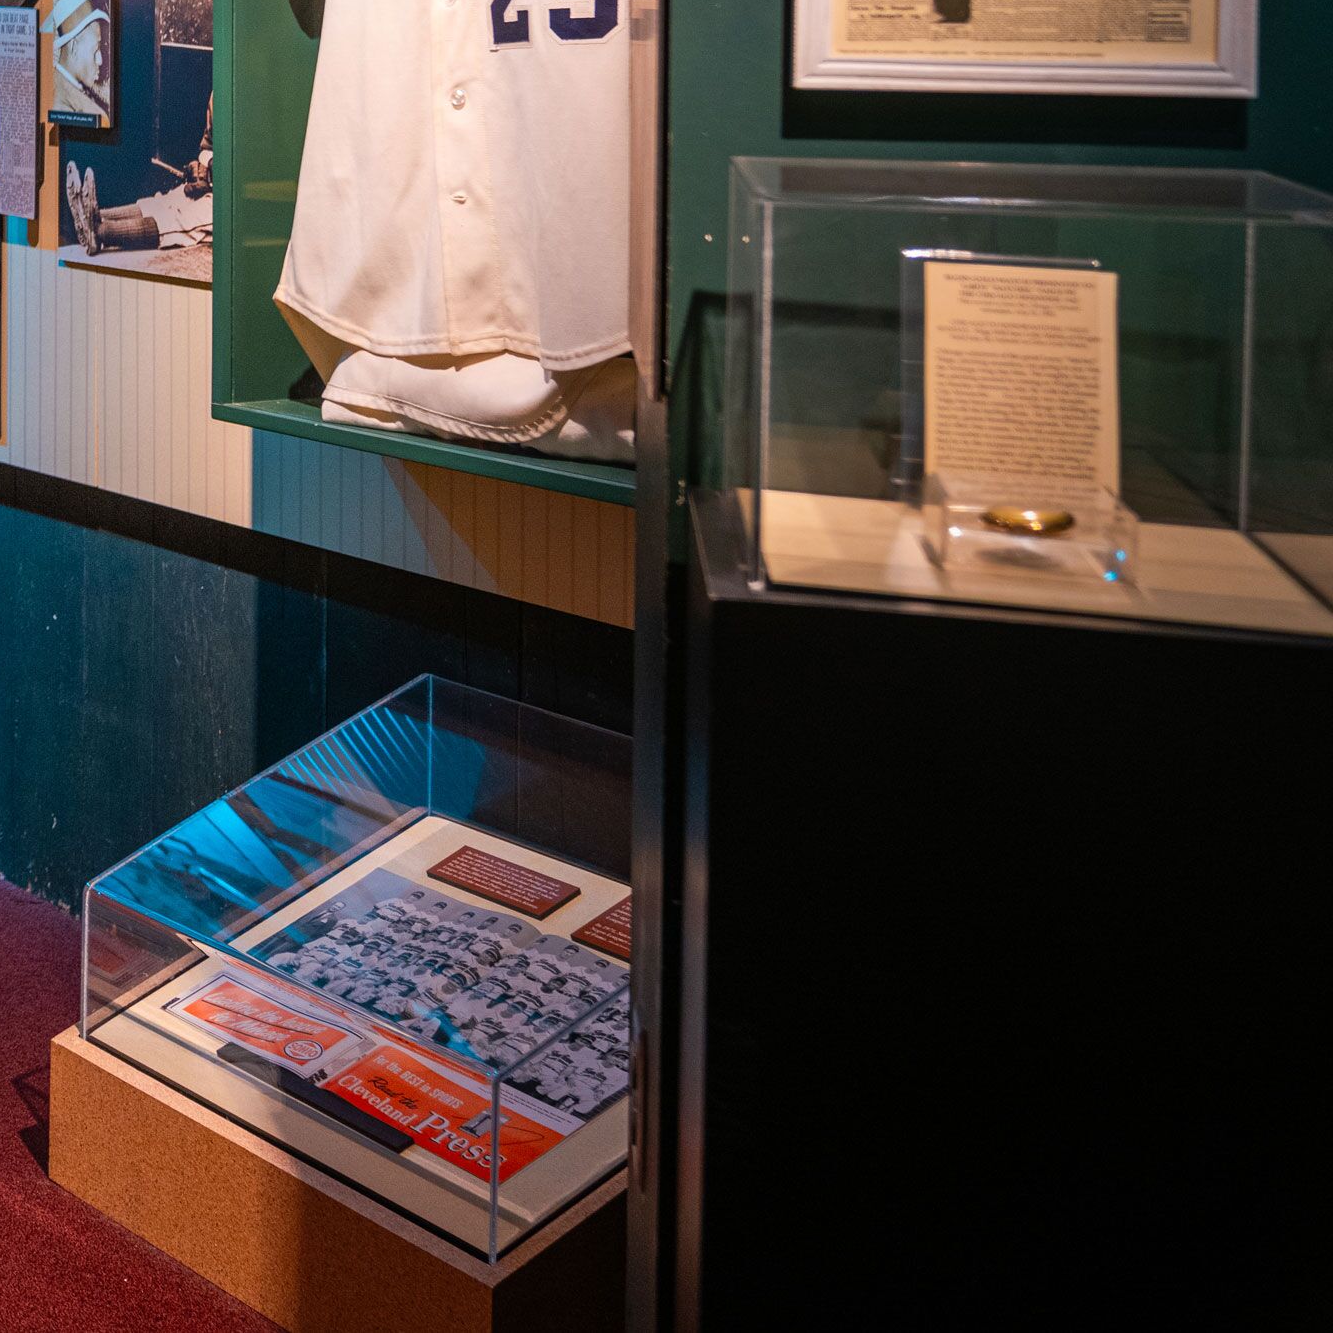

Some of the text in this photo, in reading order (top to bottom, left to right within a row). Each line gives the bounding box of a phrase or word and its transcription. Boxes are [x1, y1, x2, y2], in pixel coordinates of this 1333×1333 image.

[338, 1074, 415, 1125] Cleveland
[387, 1061, 402, 1075] the
[402, 1070, 421, 1089] BEST
[430, 1088, 464, 1108] SPORTS
[410, 1110, 508, 1169] Press
